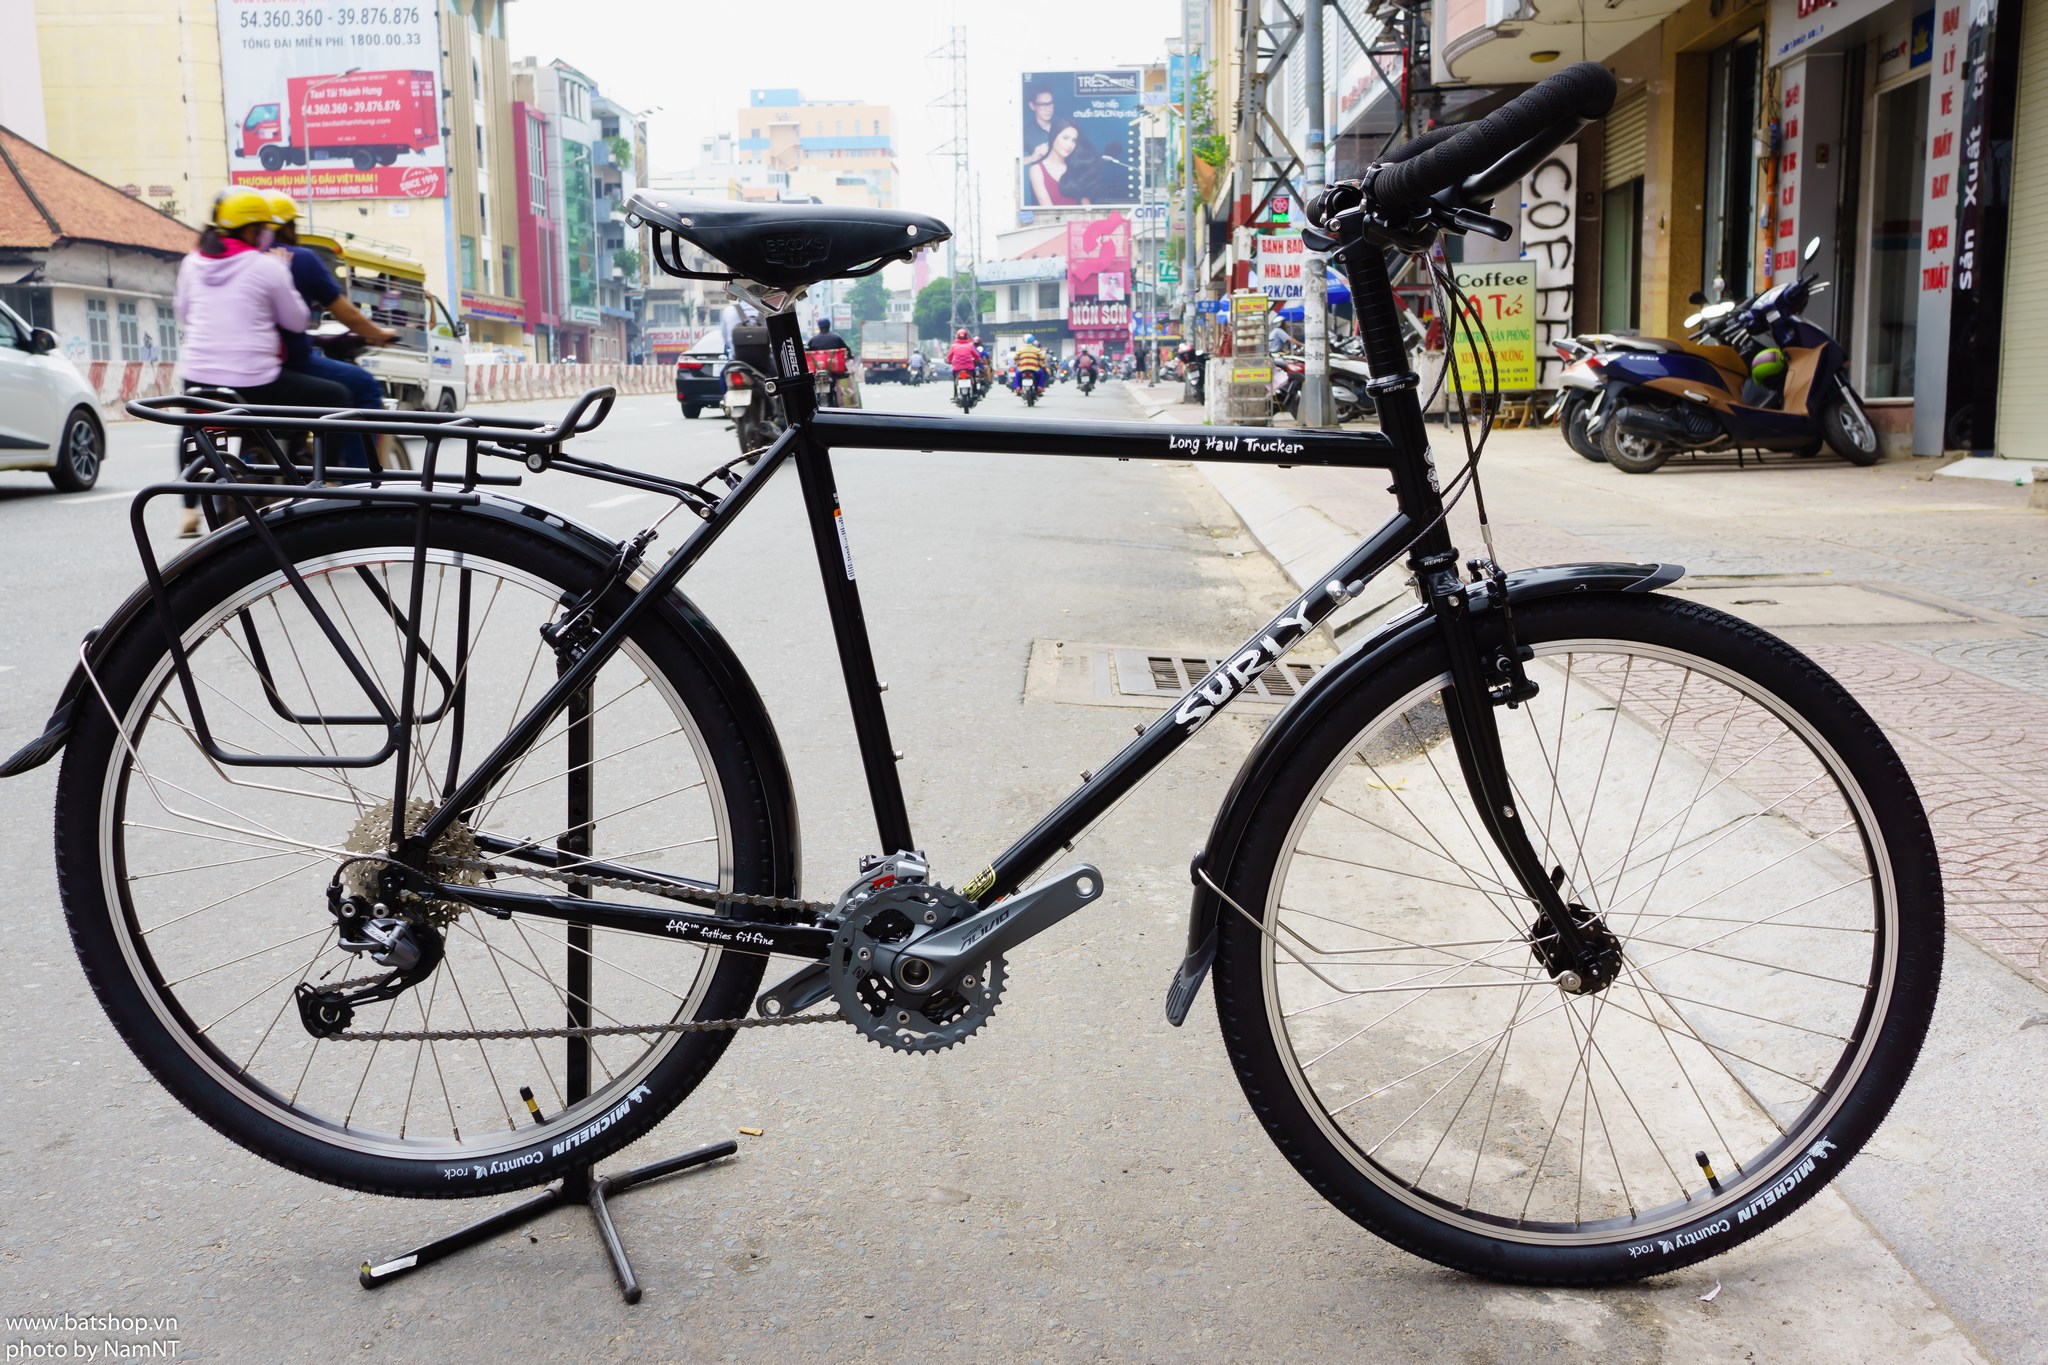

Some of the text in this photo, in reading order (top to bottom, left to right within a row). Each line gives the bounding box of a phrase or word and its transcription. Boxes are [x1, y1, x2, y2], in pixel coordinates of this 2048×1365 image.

[240, 9, 323, 28] 54.360.360
[337, 7, 419, 26] 39.876.876
[350, 33, 421, 46] 1800.00.33
[354, 100, 401, 113] 39.876.876
[355, 170, 374, 182] NAM
[1959, 51, 1988, 291] Sản xuất tại
[1931, 172, 1950, 200] BAY
[1455, 272, 1529, 289] Coffee
[1072, 300, 1128, 325] NÓN SƠN
[1382, 383, 1406, 394] KEPU
[1169, 434, 1305, 455] Long Haul Trucker
[1175, 599, 1313, 735] SURLY
[700, 926, 732, 941] fatties
[735, 931, 752, 943] fit
[752, 932, 774, 946] fine
[444, 1100, 631, 1180] MICHELIN Country rock
[1738, 1156, 1816, 1223] MICHELIN
[1675, 1219, 1731, 1248] Country
[1629, 1244, 1654, 1259] rock
